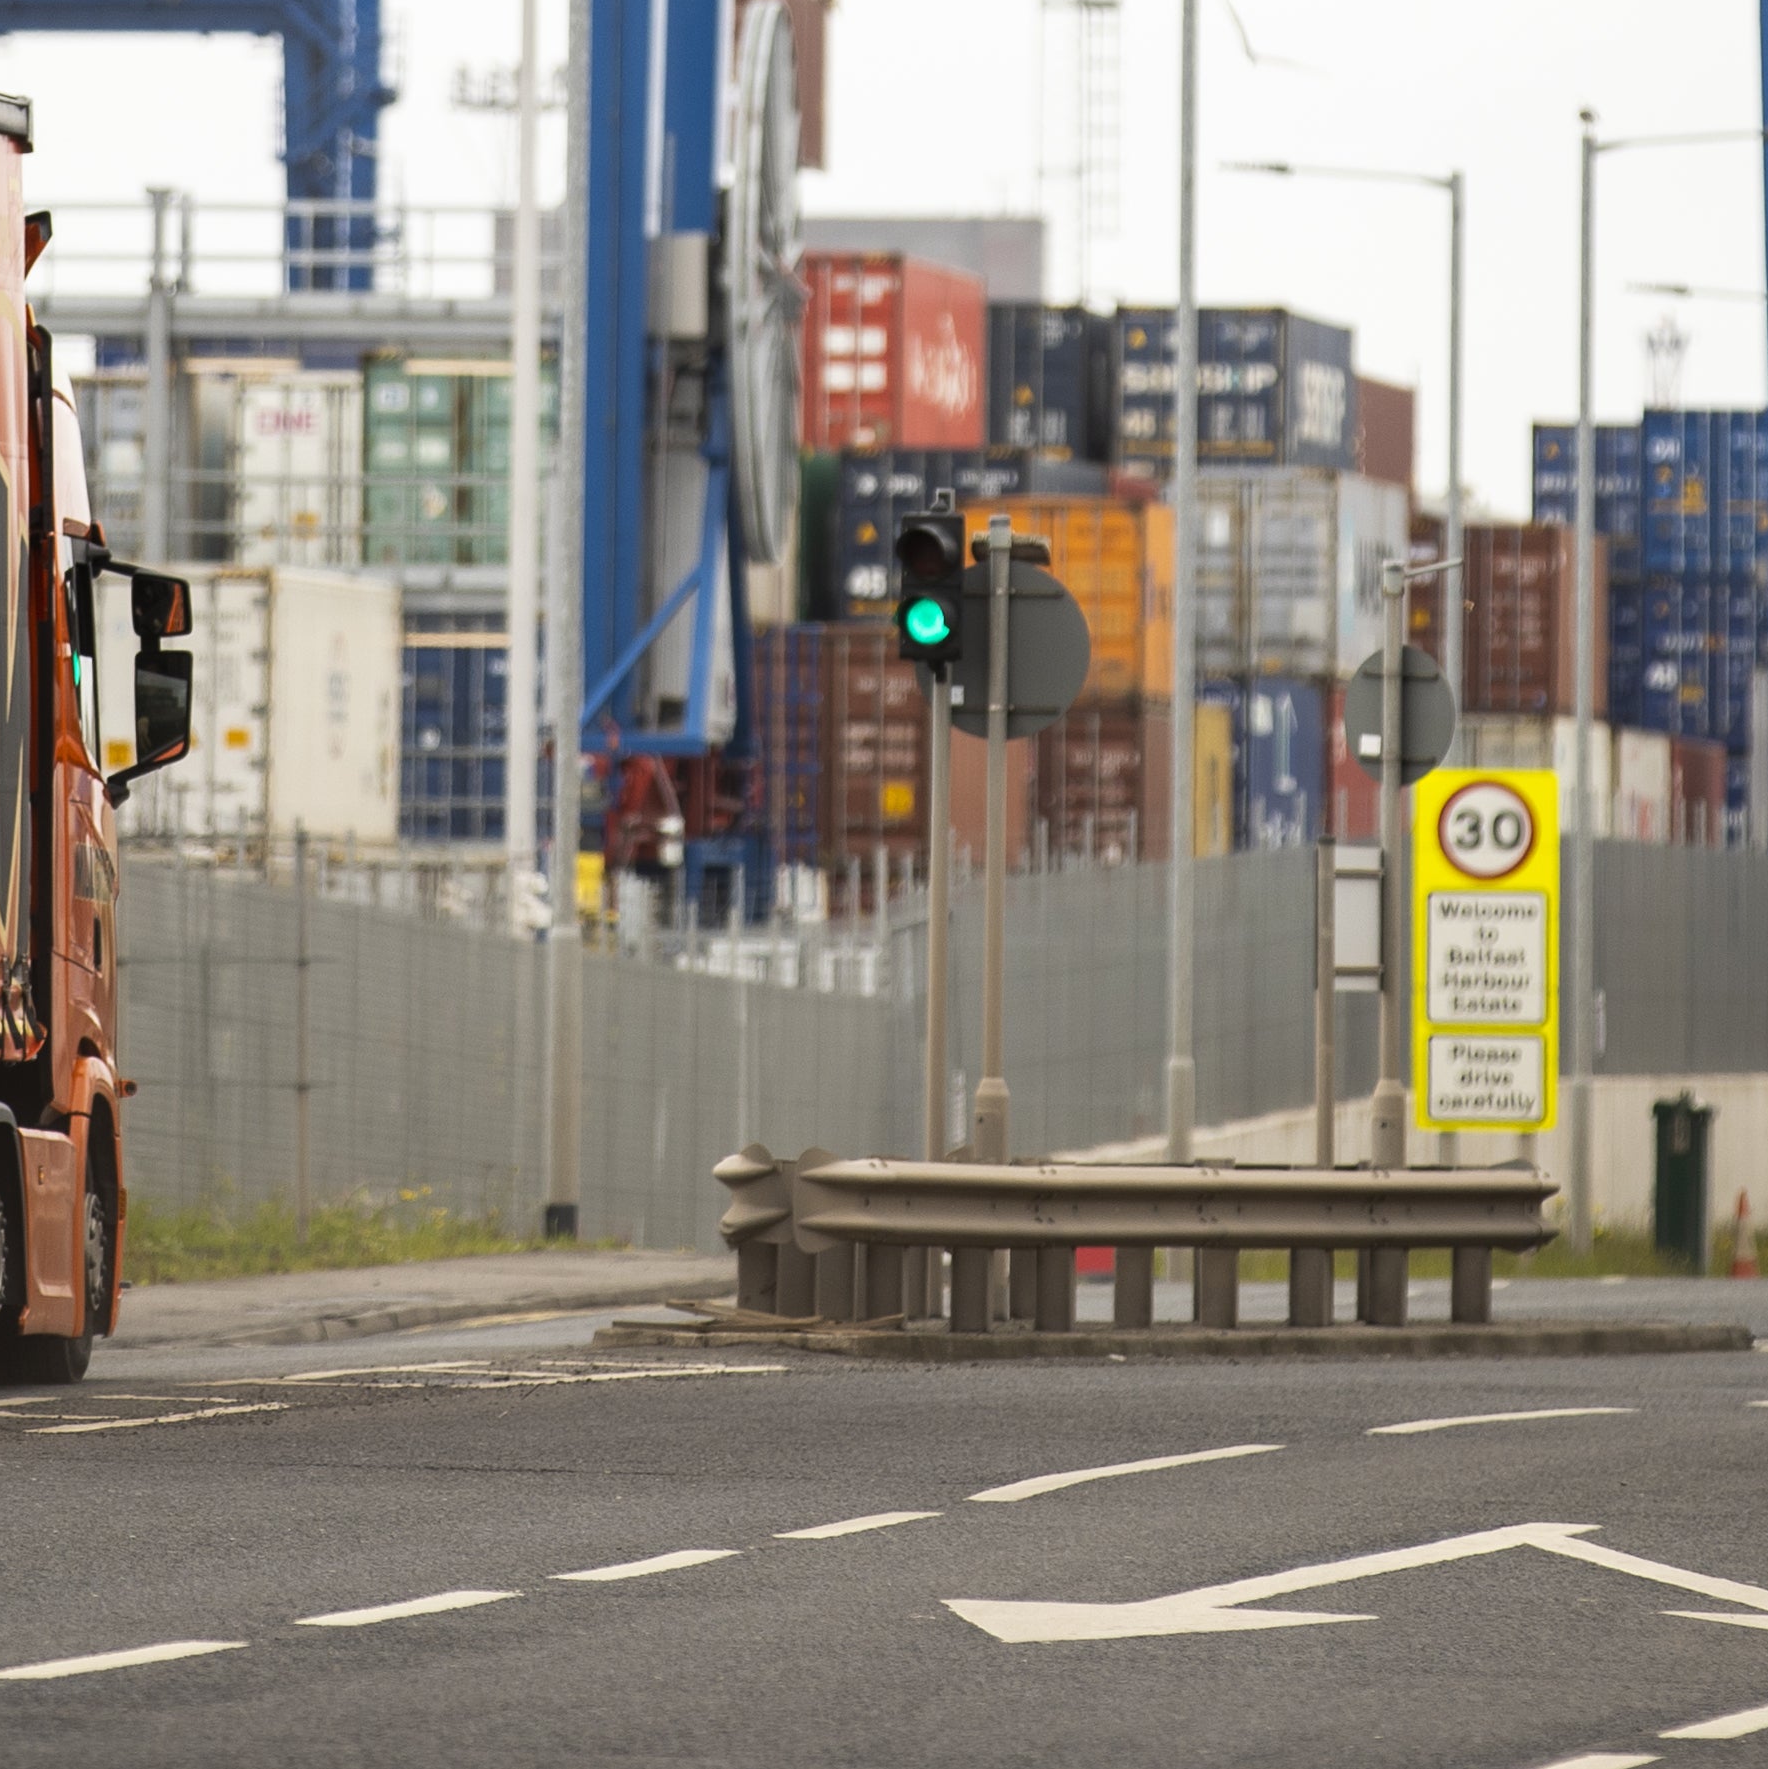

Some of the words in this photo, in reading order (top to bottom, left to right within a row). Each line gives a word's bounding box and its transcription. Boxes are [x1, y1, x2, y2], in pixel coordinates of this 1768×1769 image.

[1453, 808, 1522, 850] 30
[1439, 900, 1537, 920] Welcome
[1476, 925, 1499, 943] to
[1448, 947, 1526, 966] Belfast
[1441, 972, 1530, 990] Harbour
[1452, 995, 1522, 1012] Estate
[1452, 1044, 1521, 1063] Please
[1458, 1068, 1512, 1086] drive
[1438, 1091, 1535, 1116] carefully
